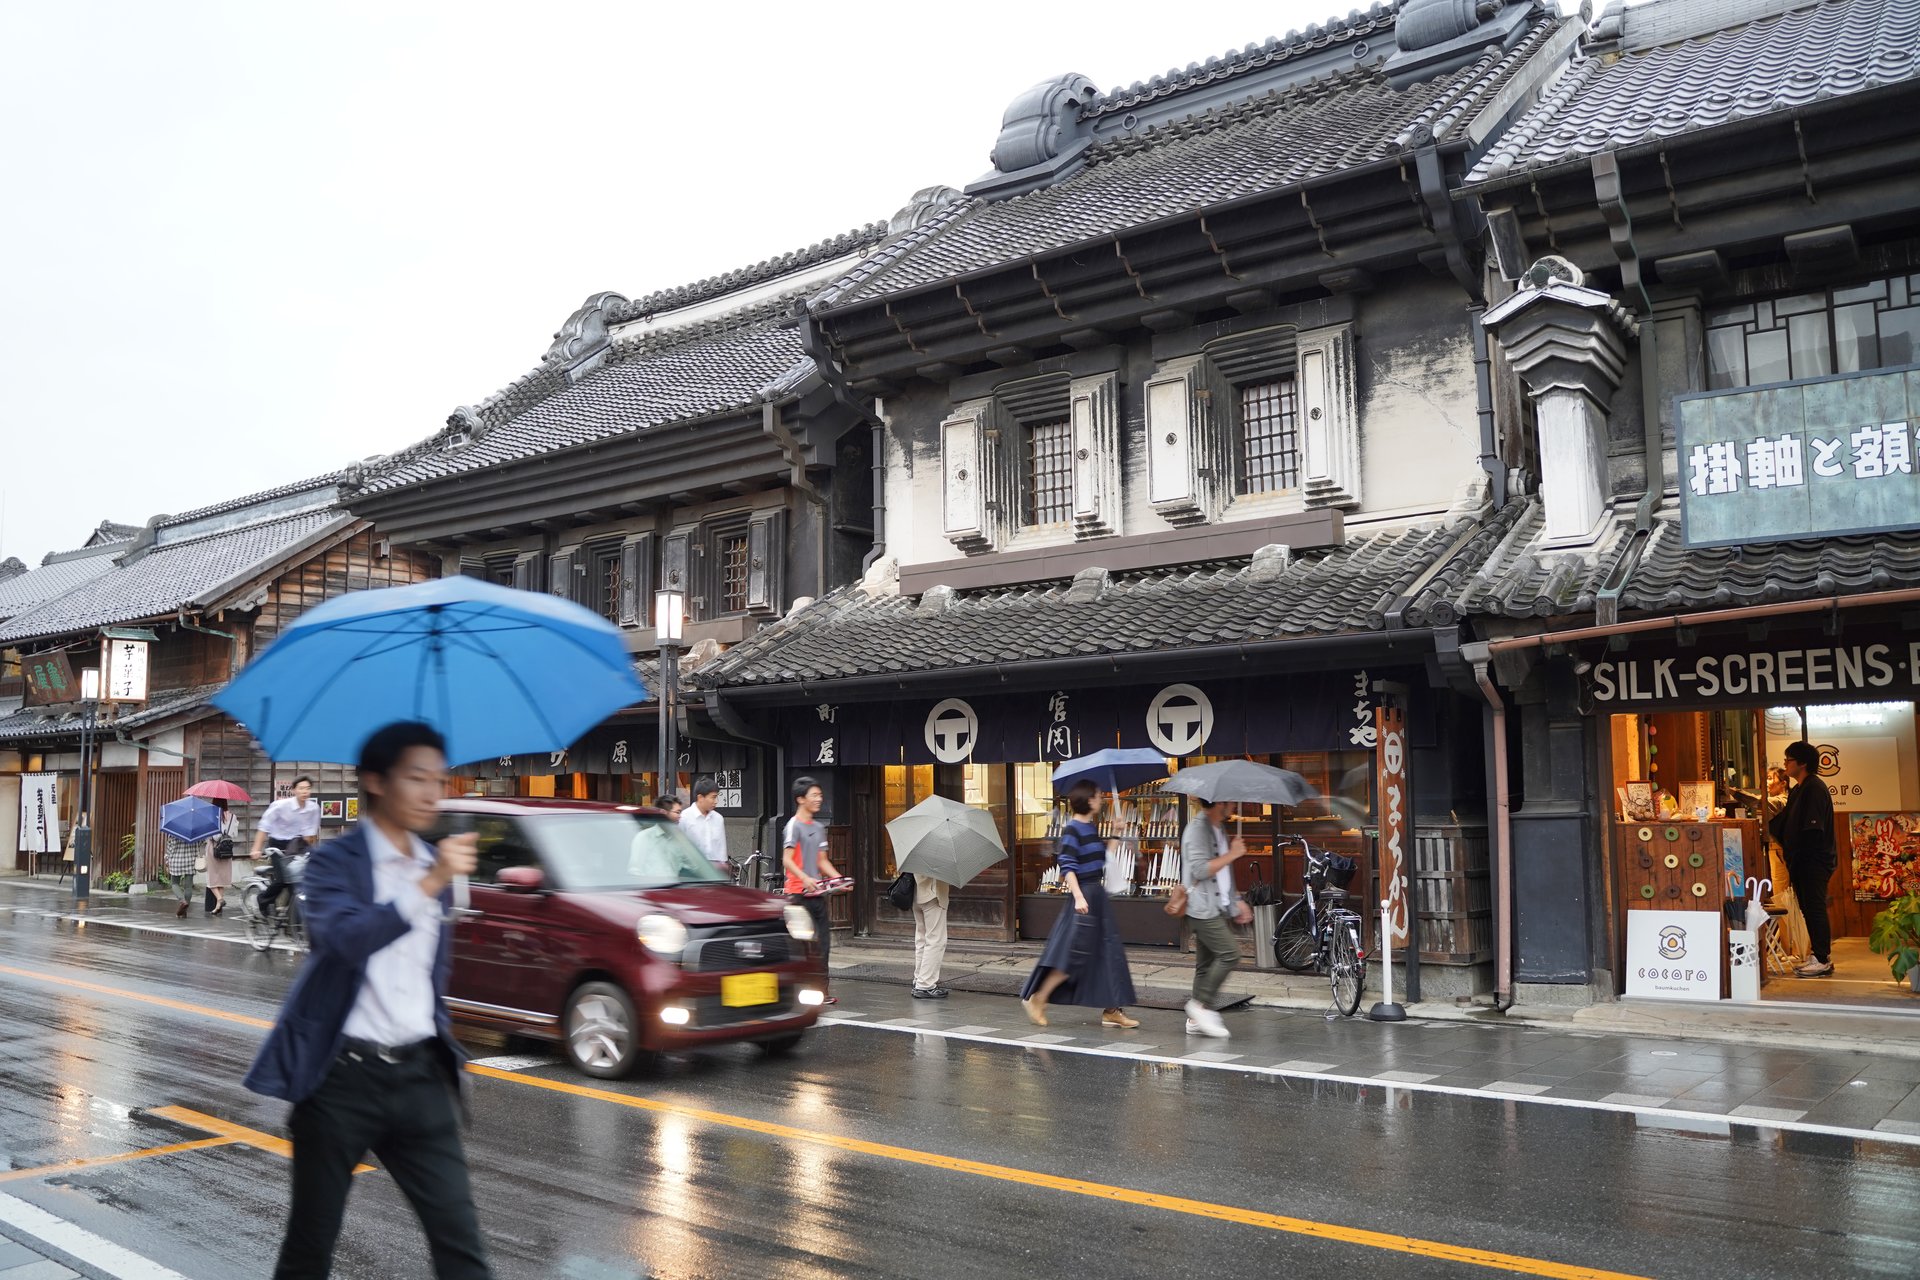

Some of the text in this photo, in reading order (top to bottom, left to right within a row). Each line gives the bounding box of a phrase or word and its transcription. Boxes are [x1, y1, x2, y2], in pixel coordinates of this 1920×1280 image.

[1689, 421, 1920, 497] 掛軸と額
[815, 703, 839, 764] 町屋
[1046, 690, 1073, 759] 宮岡
[1348, 669, 1378, 748] まちや
[1874, 819, 1901, 898] 川越まつり
[1638, 967, 1708, 982] cocoro
[1655, 984, 1691, 992] baumkuchen
